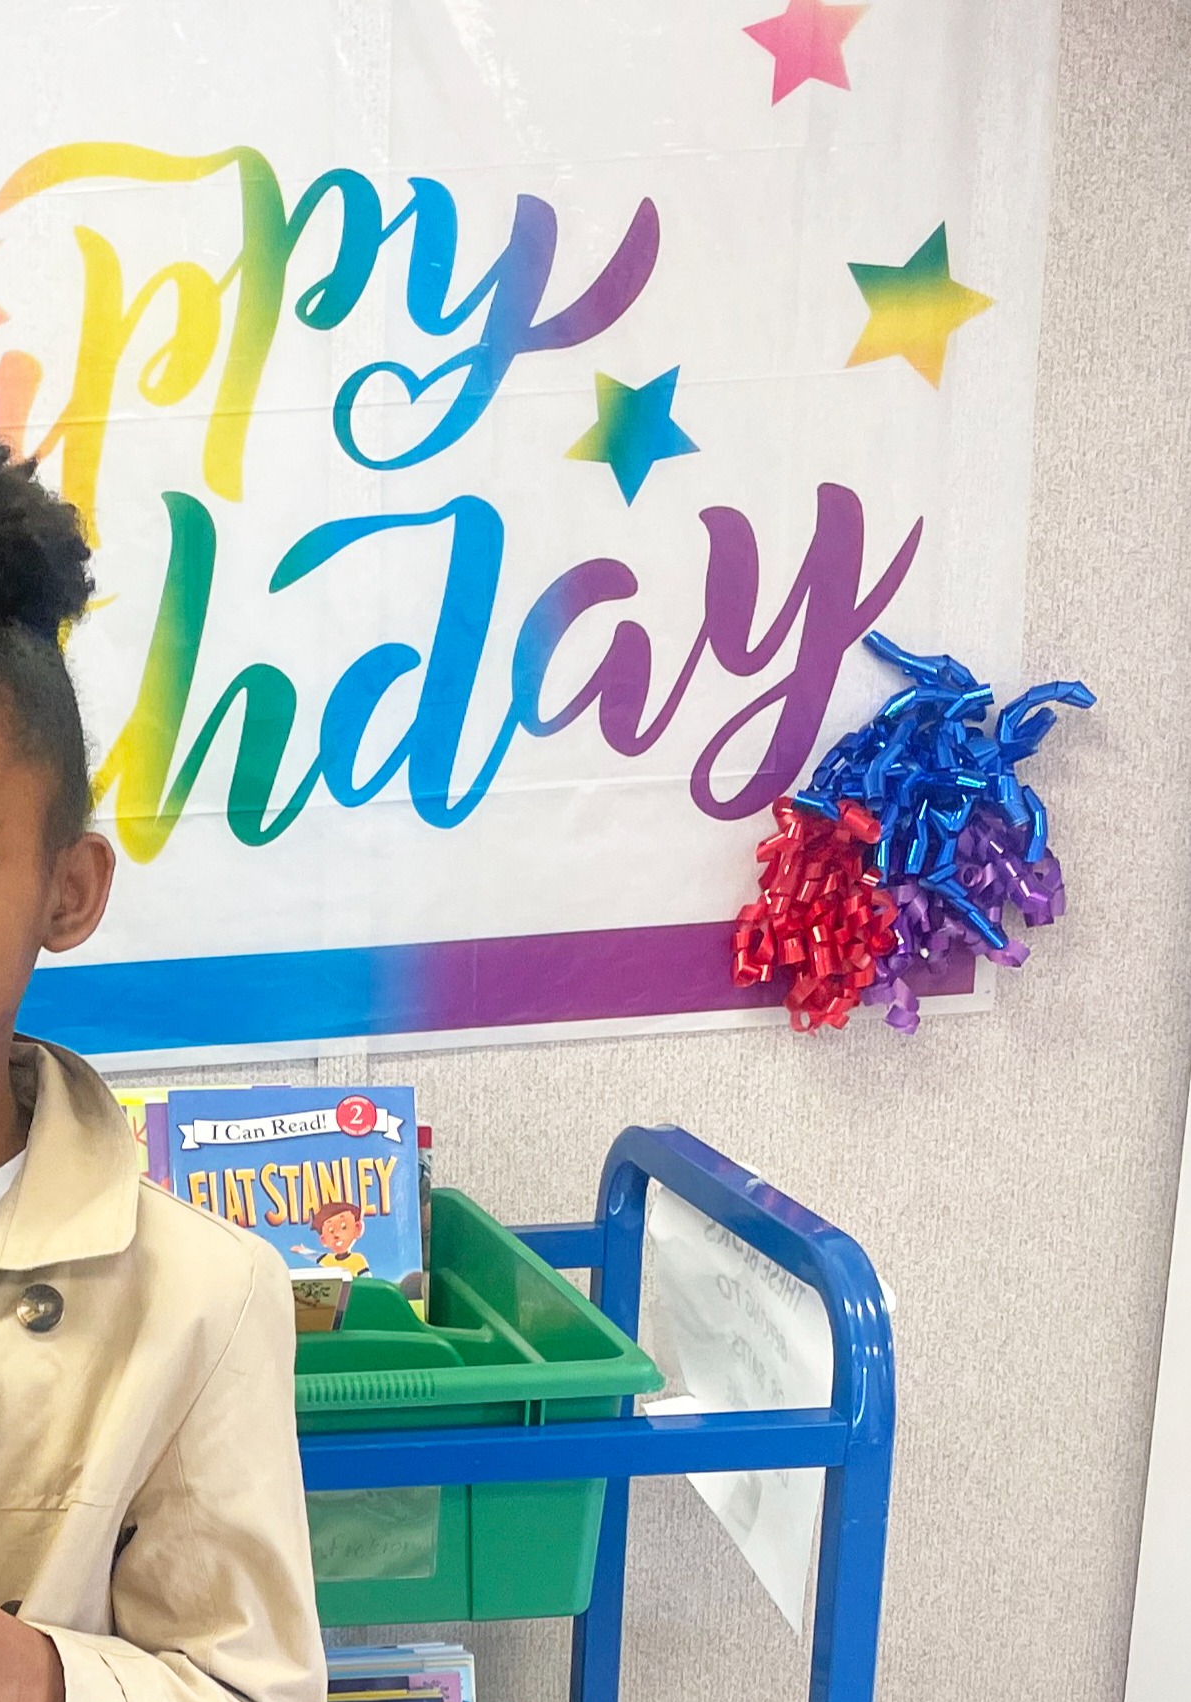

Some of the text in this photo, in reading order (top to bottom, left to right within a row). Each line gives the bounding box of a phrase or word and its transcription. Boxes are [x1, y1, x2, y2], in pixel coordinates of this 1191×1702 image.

[211, 1124, 219, 1141] I
[225, 1124, 265, 1142] Can
[272, 1114, 328, 1136] Read!
[349, 1104, 364, 1125] 2
[260, 1155, 398, 1226] STANLEY
